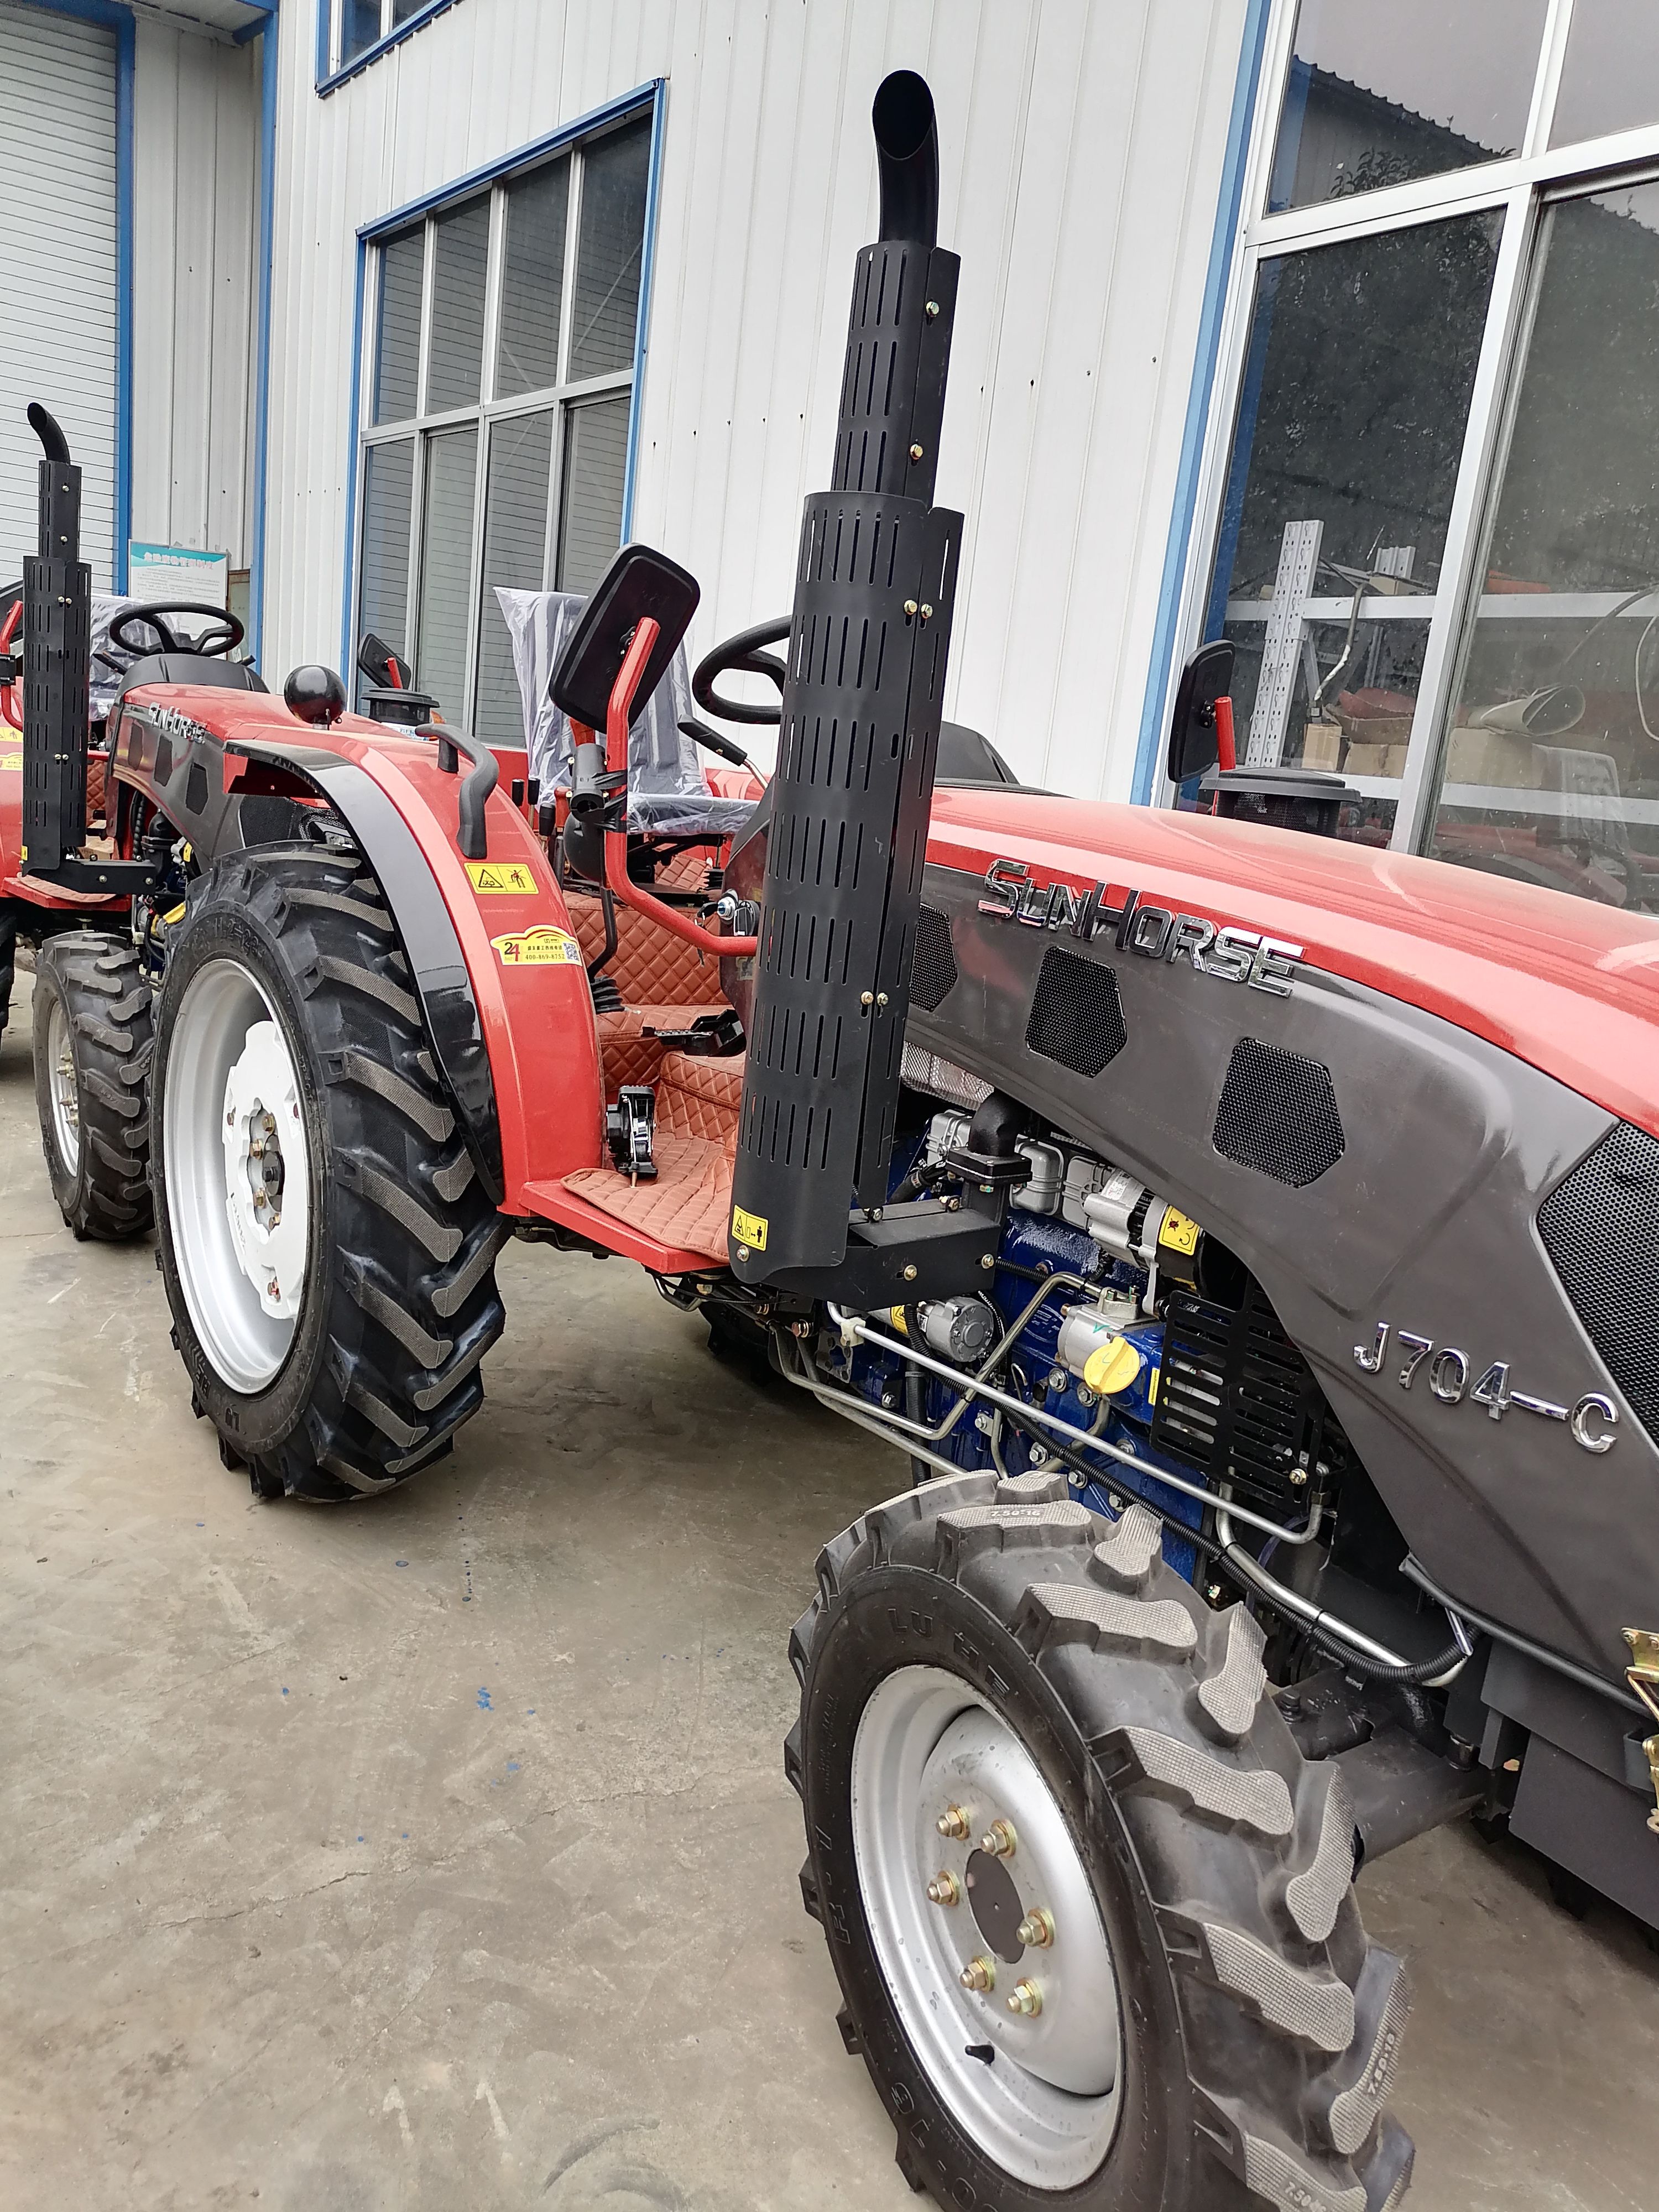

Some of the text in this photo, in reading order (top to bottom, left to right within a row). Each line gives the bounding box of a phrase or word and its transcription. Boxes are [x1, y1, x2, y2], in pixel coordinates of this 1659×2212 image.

[148, 702, 208, 744] SUNHORSE
[504, 942, 520, 962] 24
[977, 858, 1309, 999] SUNHORSE
[1353, 1321, 1620, 1453] J704-C
